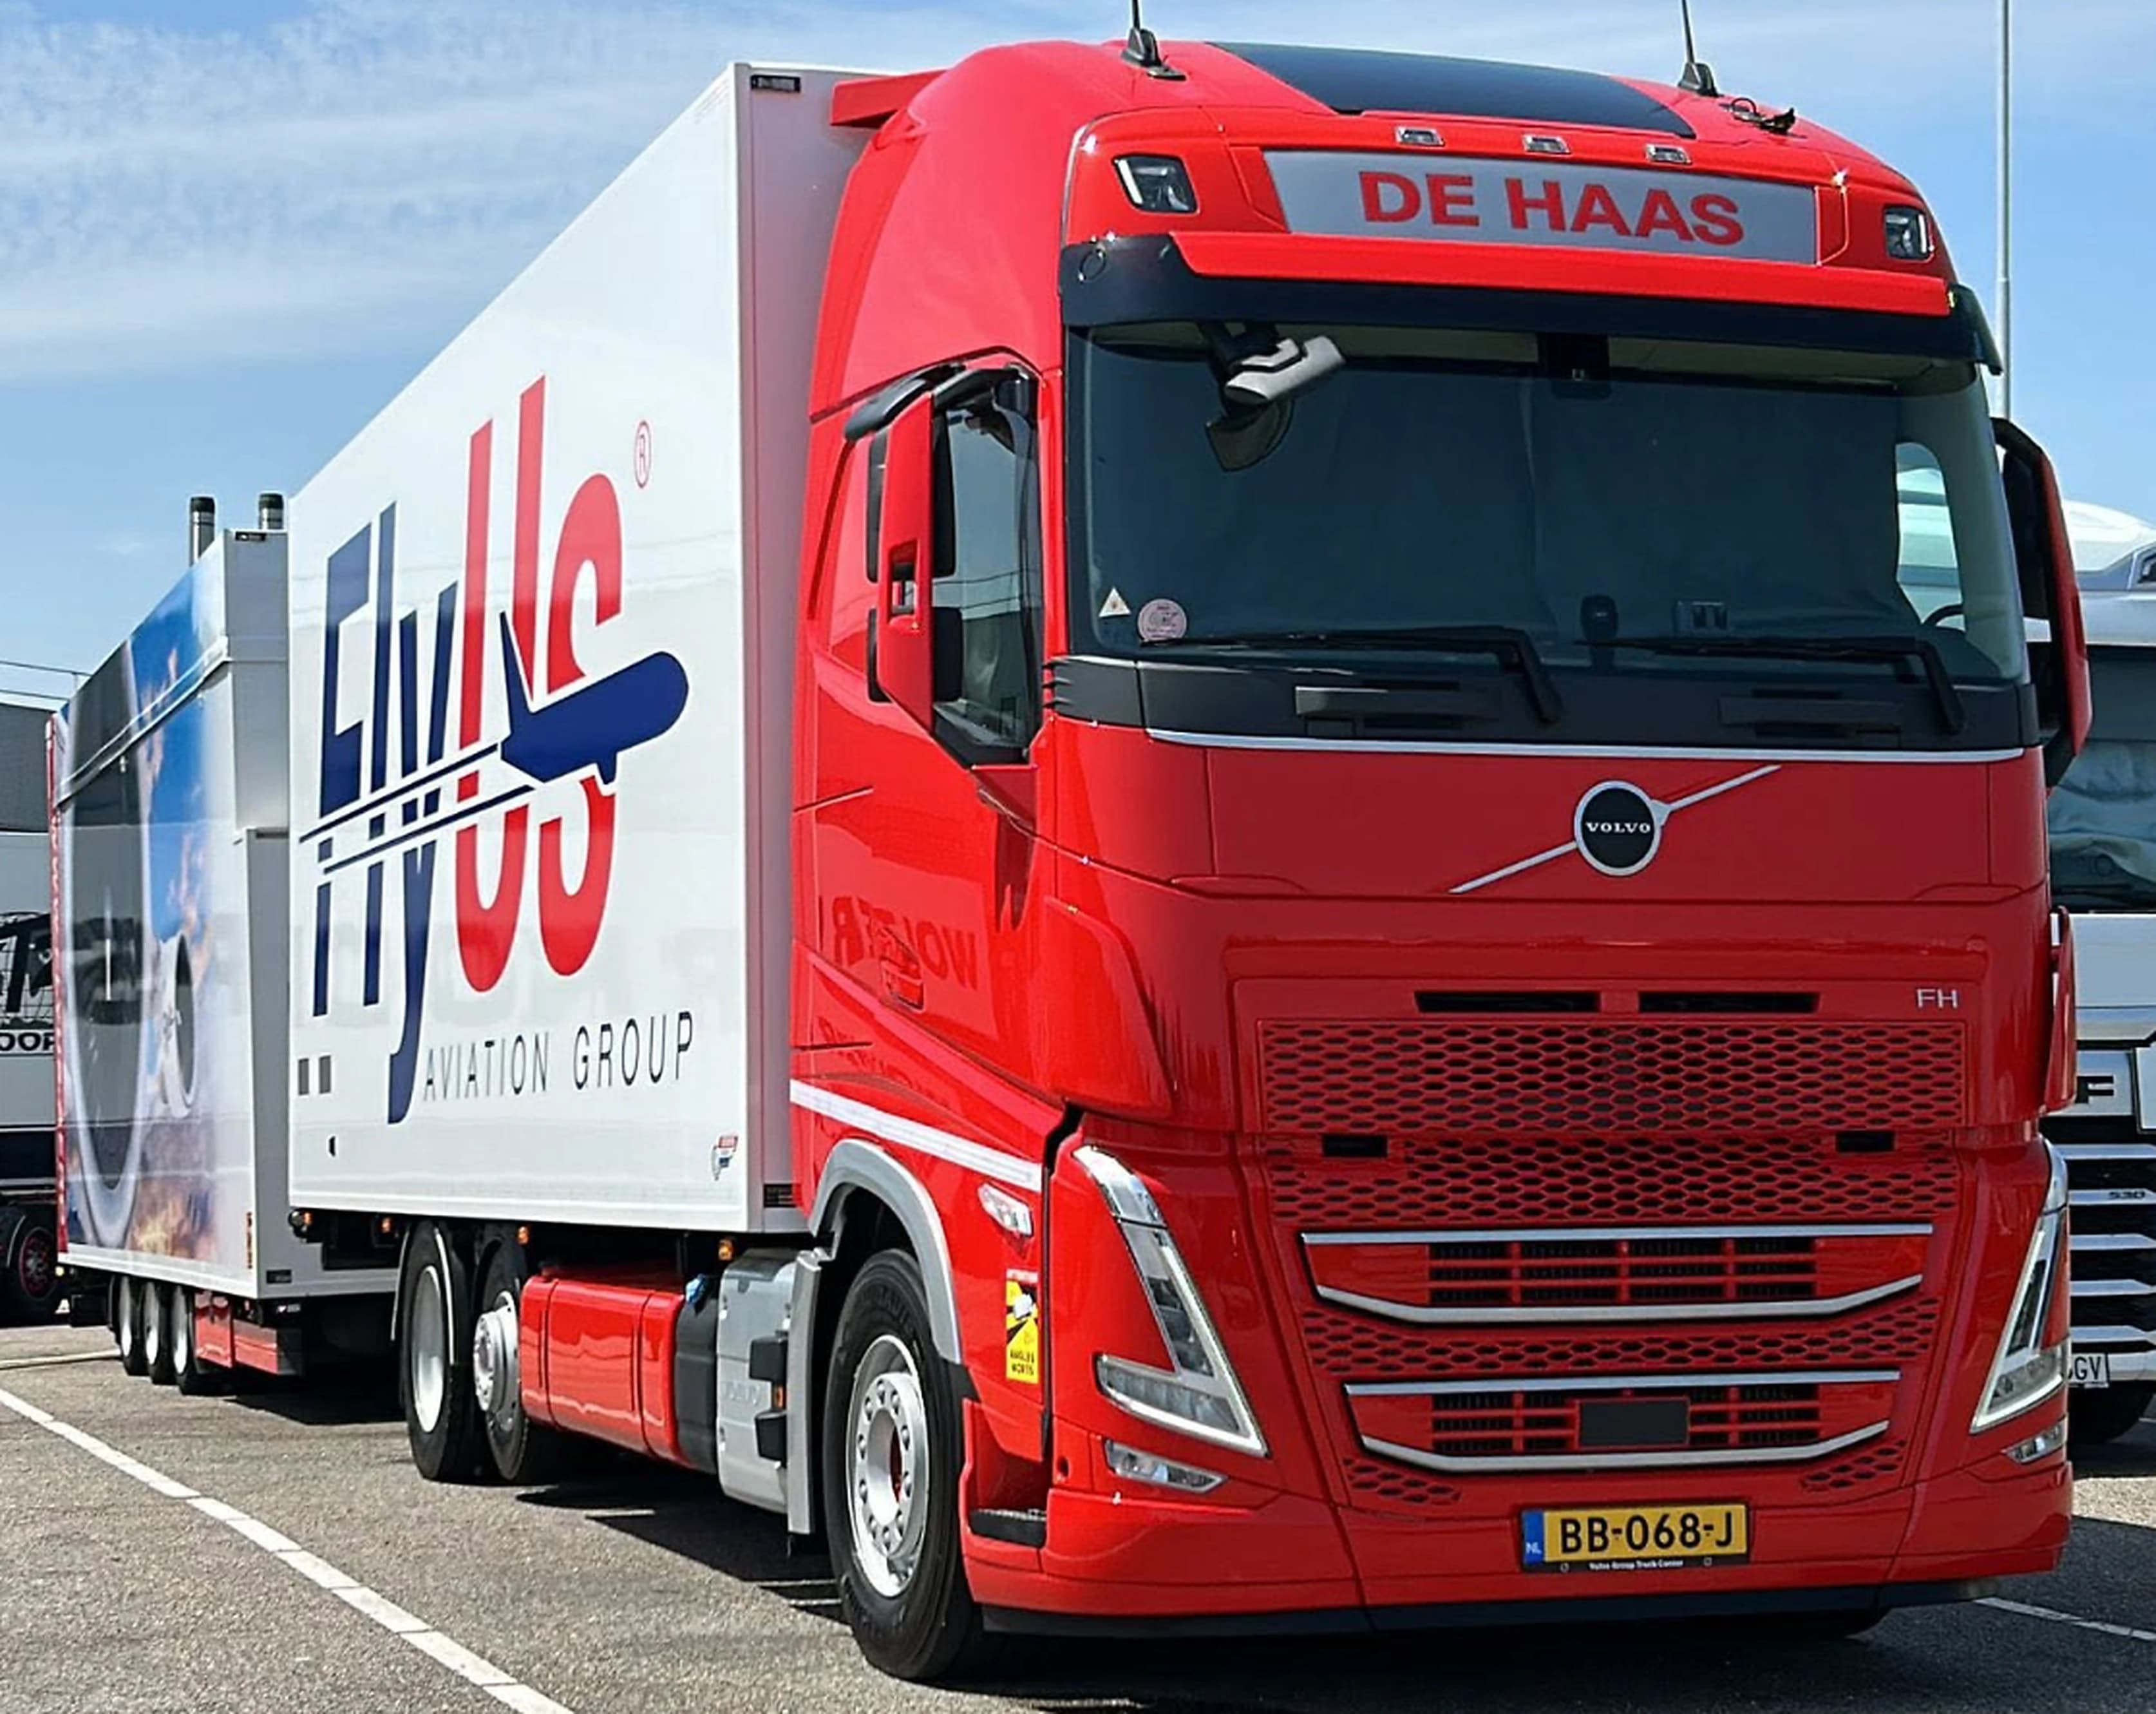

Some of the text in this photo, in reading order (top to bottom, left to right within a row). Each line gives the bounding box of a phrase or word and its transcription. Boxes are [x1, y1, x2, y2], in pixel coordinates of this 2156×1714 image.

[1359, 171, 1745, 246] DE HAAS
[1585, 822, 1651, 834] VOLVO
[1916, 989, 1959, 1008] FH
[424, 1011, 694, 1101] AVIATION GROUP
[1560, 1512, 1733, 1554] BB-068-J
[1526, 1543, 1542, 1556] NL
